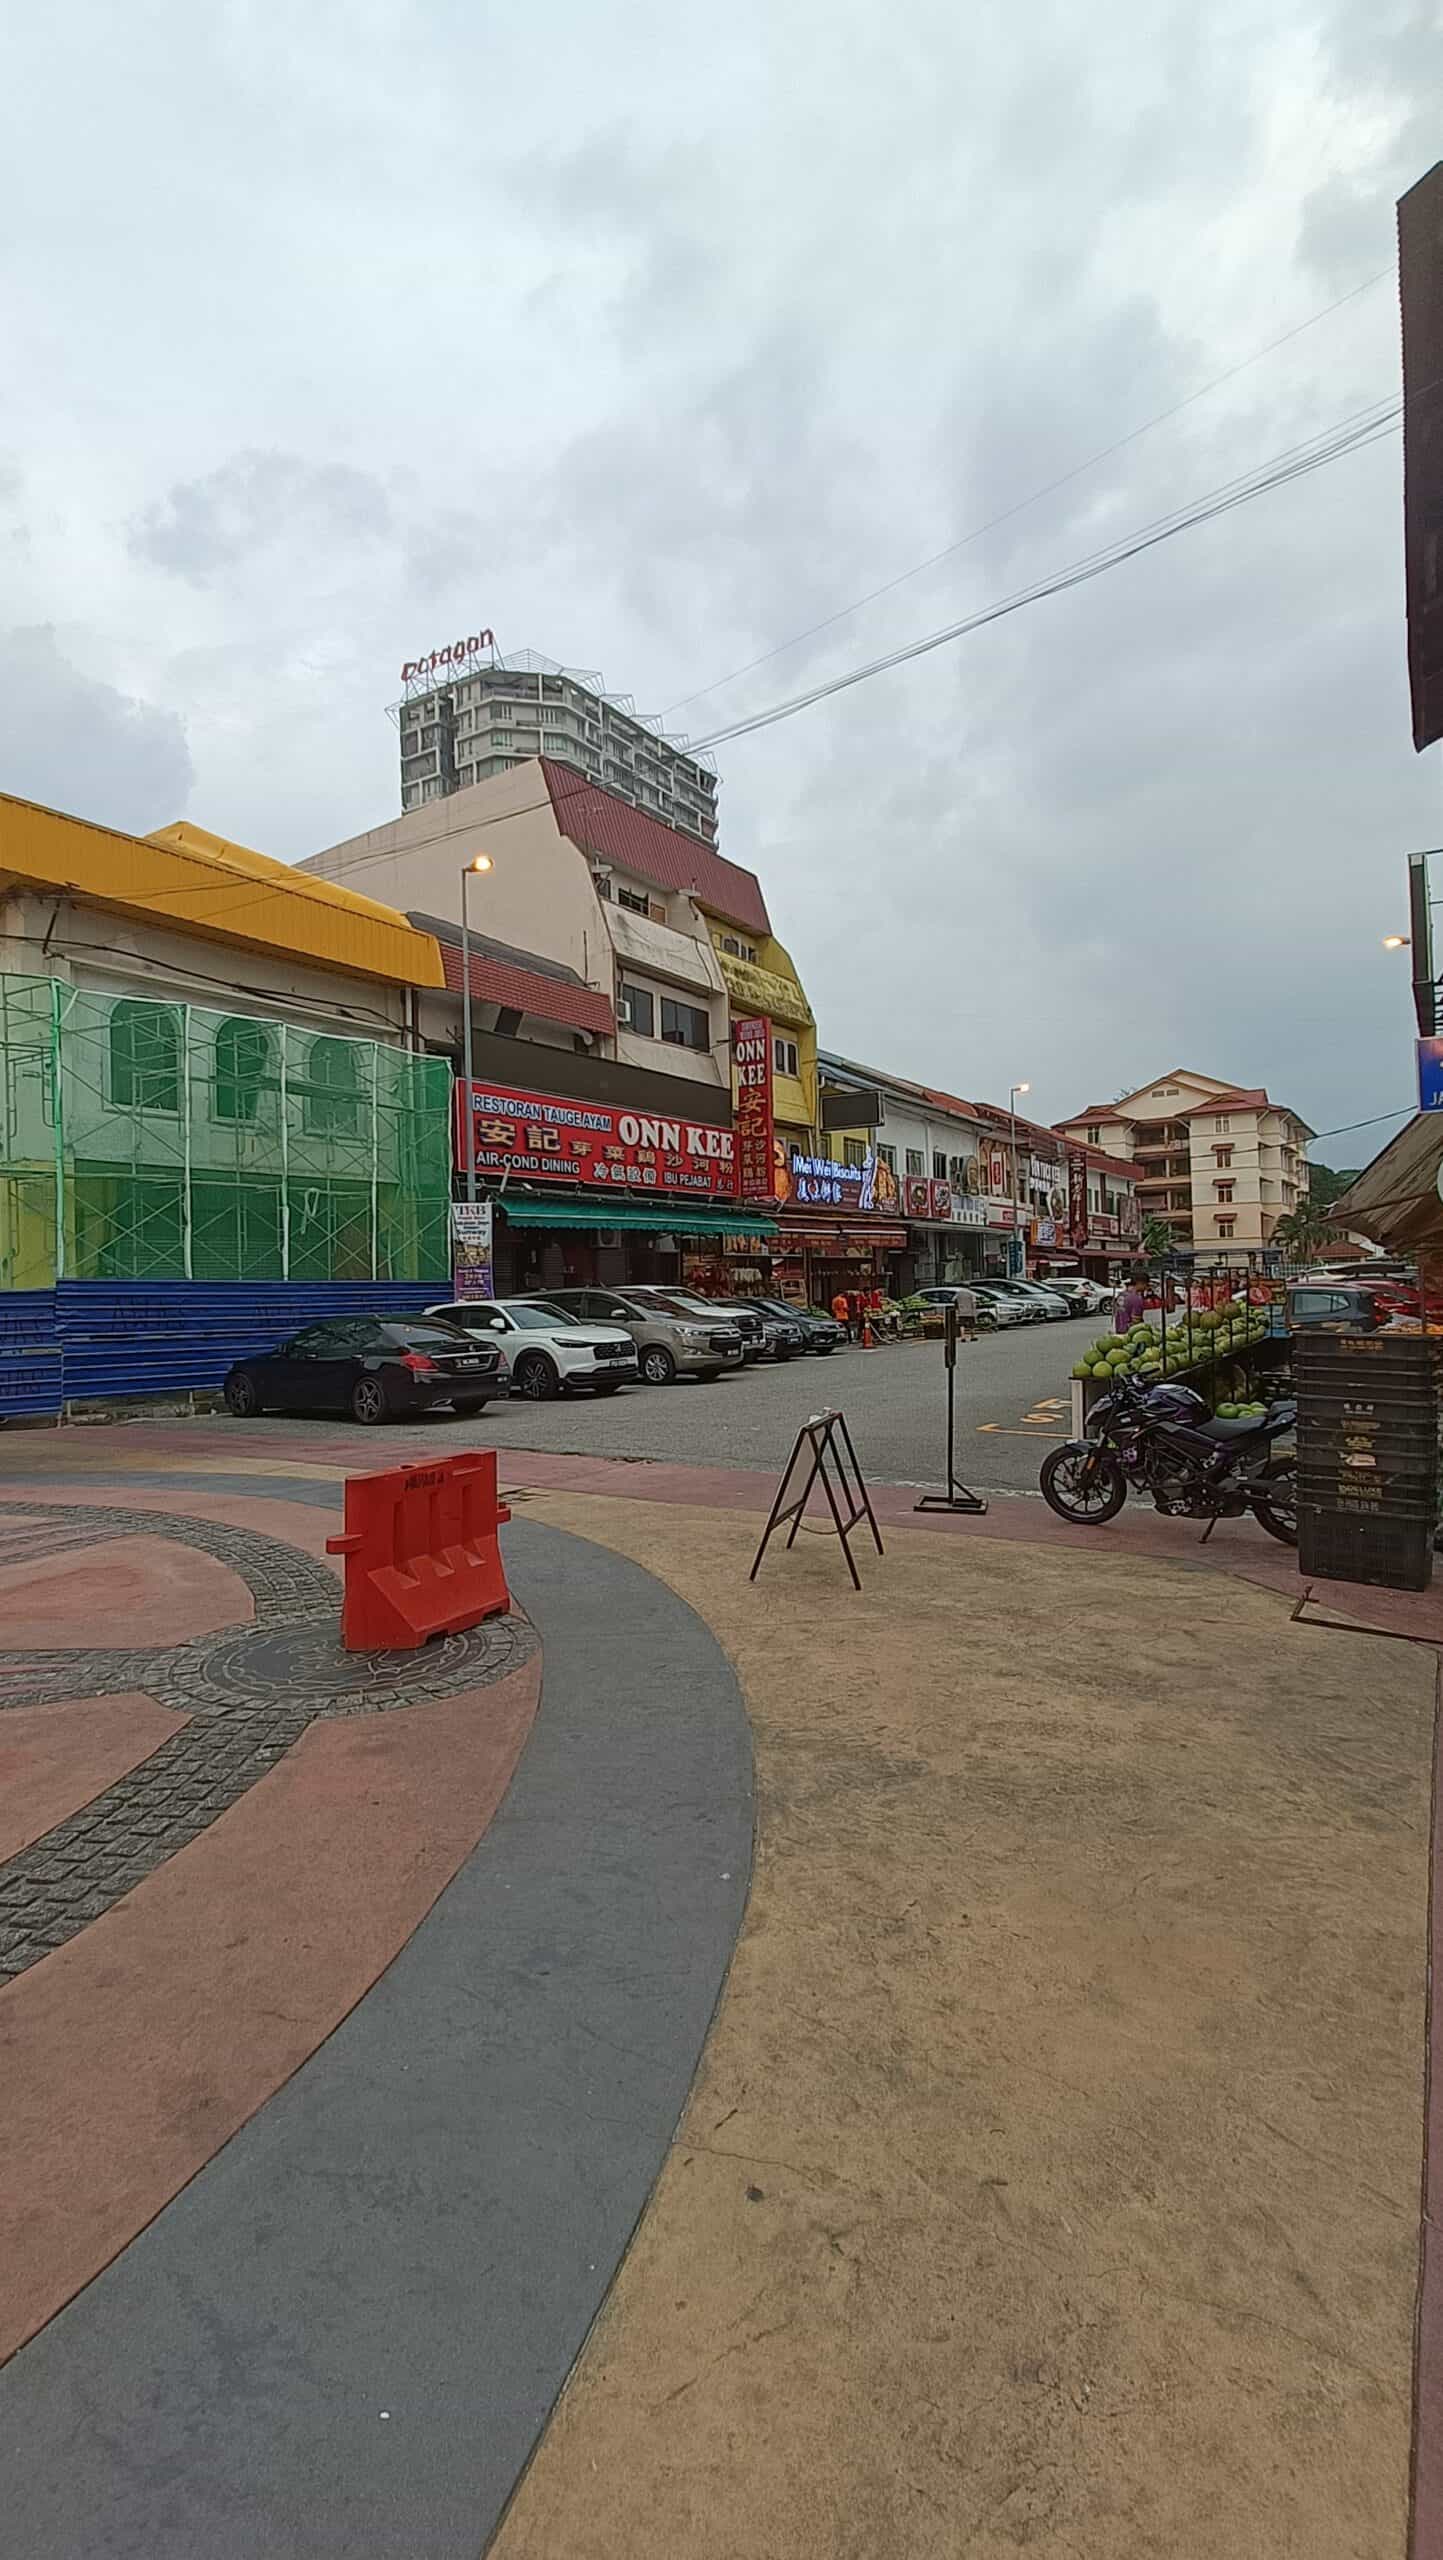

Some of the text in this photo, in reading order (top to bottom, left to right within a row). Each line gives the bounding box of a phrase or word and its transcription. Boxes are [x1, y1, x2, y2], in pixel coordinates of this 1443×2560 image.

[736, 1040, 765, 1062] ONN
[737, 1064, 765, 1087] KEE
[473, 1093, 612, 1131] RESTORAN TAUGE AYAM
[619, 1115, 680, 1152] ONN
[686, 1127, 734, 1160] KEE
[476, 1151, 580, 1174] AIR-COND DINING
